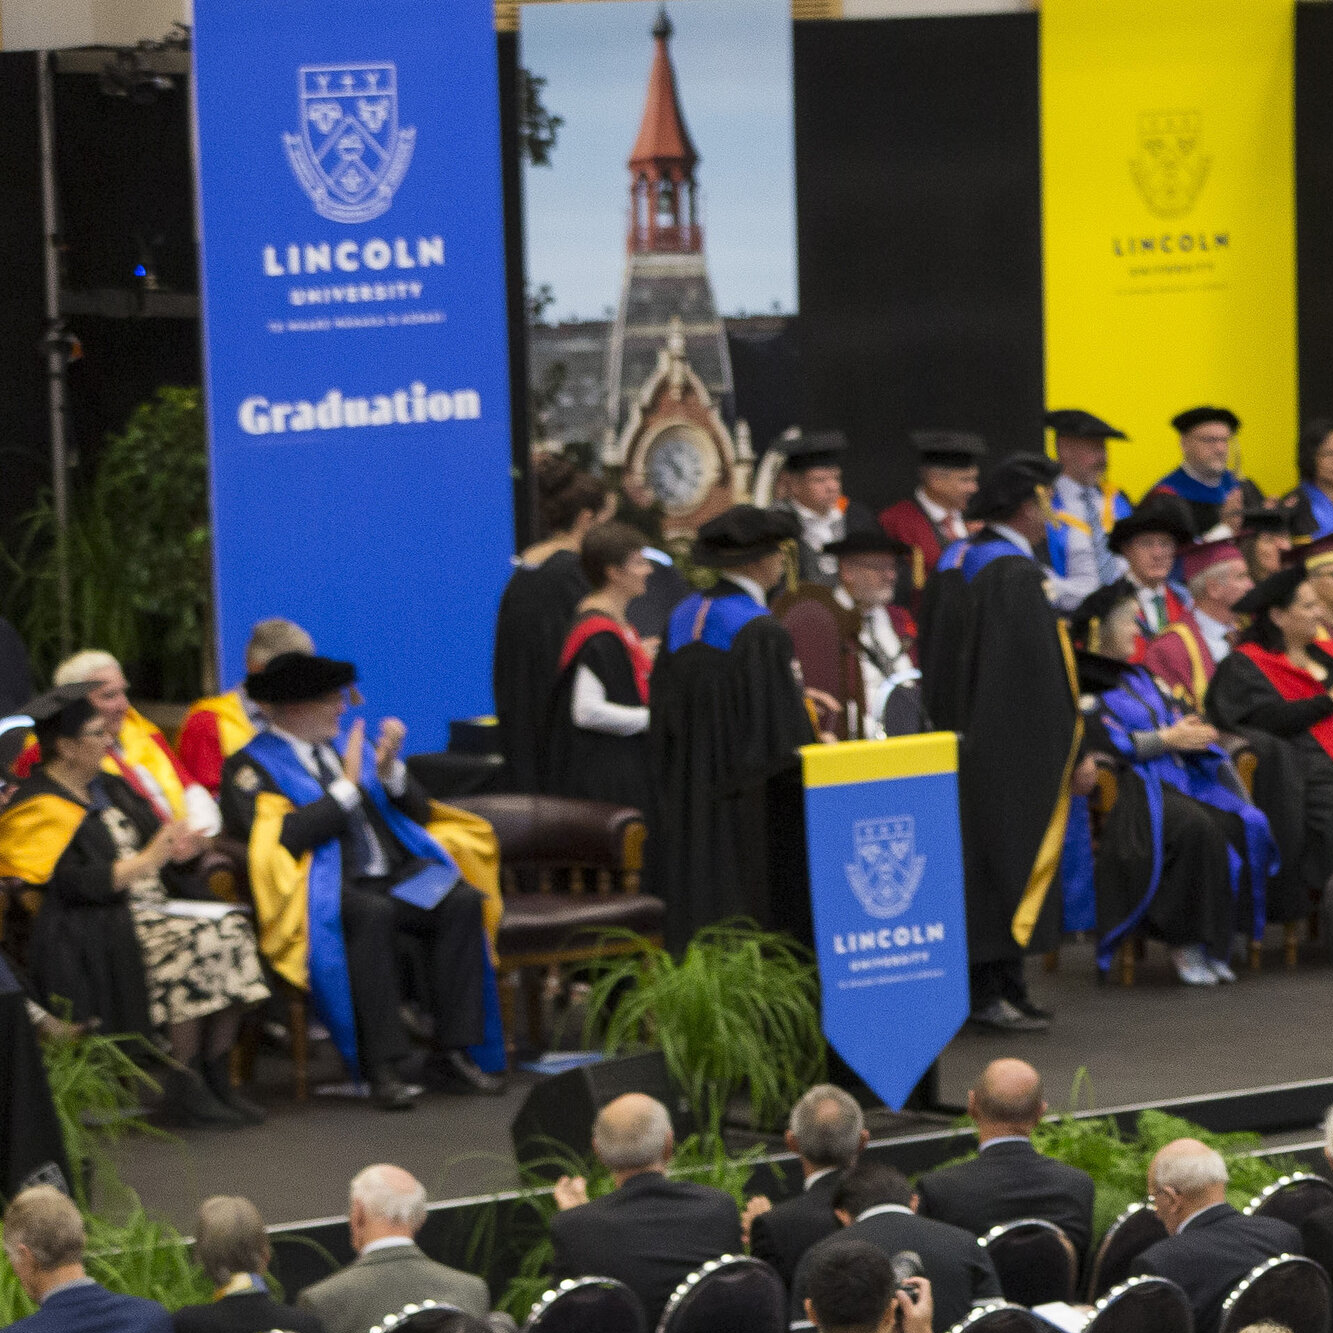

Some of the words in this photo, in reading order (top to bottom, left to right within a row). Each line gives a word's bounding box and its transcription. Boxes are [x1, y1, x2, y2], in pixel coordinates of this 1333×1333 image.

[263, 236, 445, 276] LINCOLN
[1112, 234, 1229, 256] LINCOLN
[289, 281, 422, 305] UNIVERSITY
[238, 382, 481, 435] Graduation
[833, 922, 944, 954] LINCOLN
